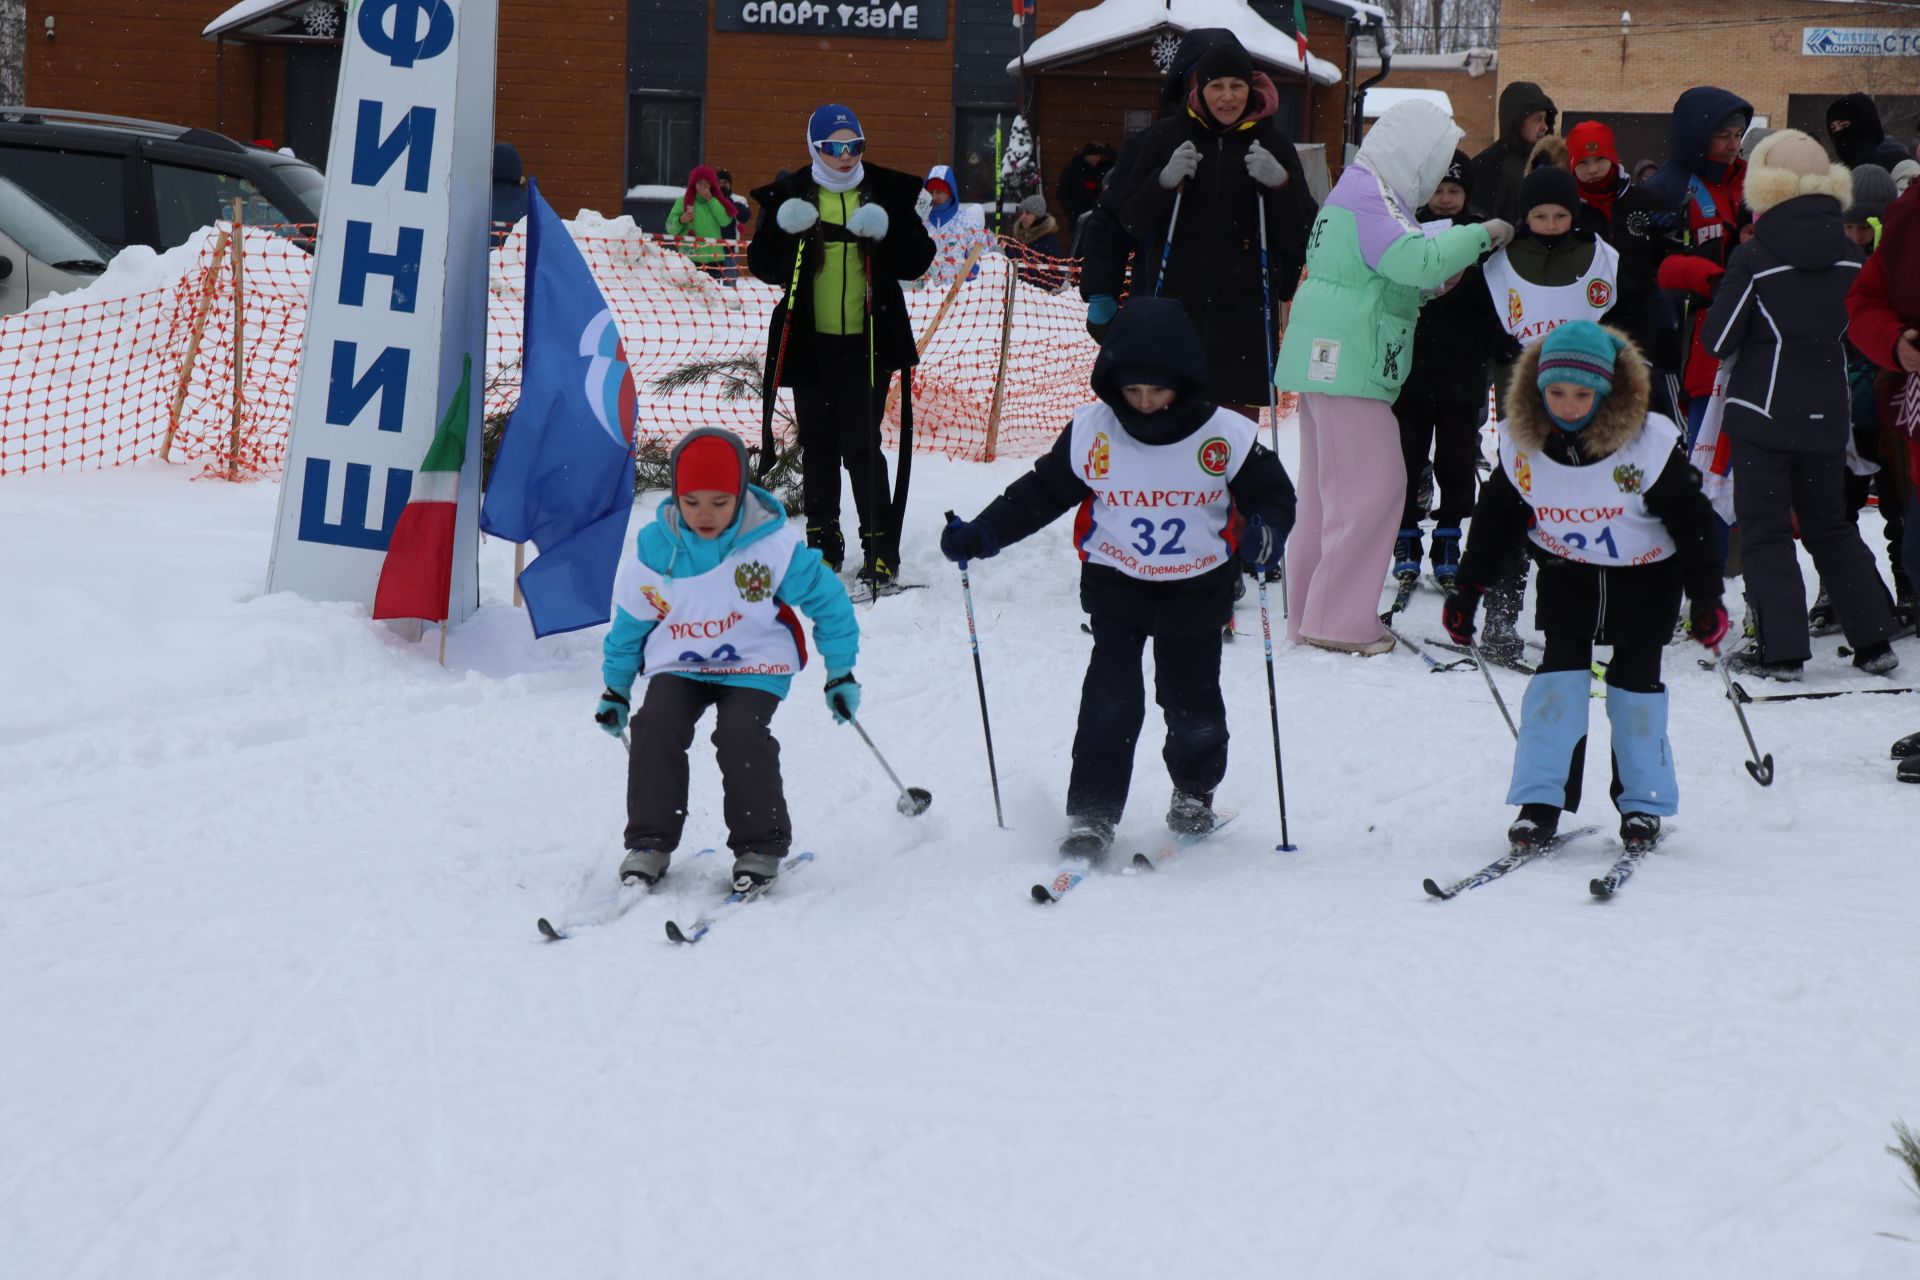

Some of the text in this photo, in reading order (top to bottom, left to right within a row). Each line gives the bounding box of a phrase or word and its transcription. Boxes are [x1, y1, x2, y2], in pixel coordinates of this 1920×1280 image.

[742, 1, 829, 25] СПОРТ
[298, 0, 455, 551] ФИНИШ
[1094, 489, 1223, 507] ТАТАРСТАН
[1536, 507, 1623, 523] РОССИЯ
[1130, 517, 1187, 557] 32
